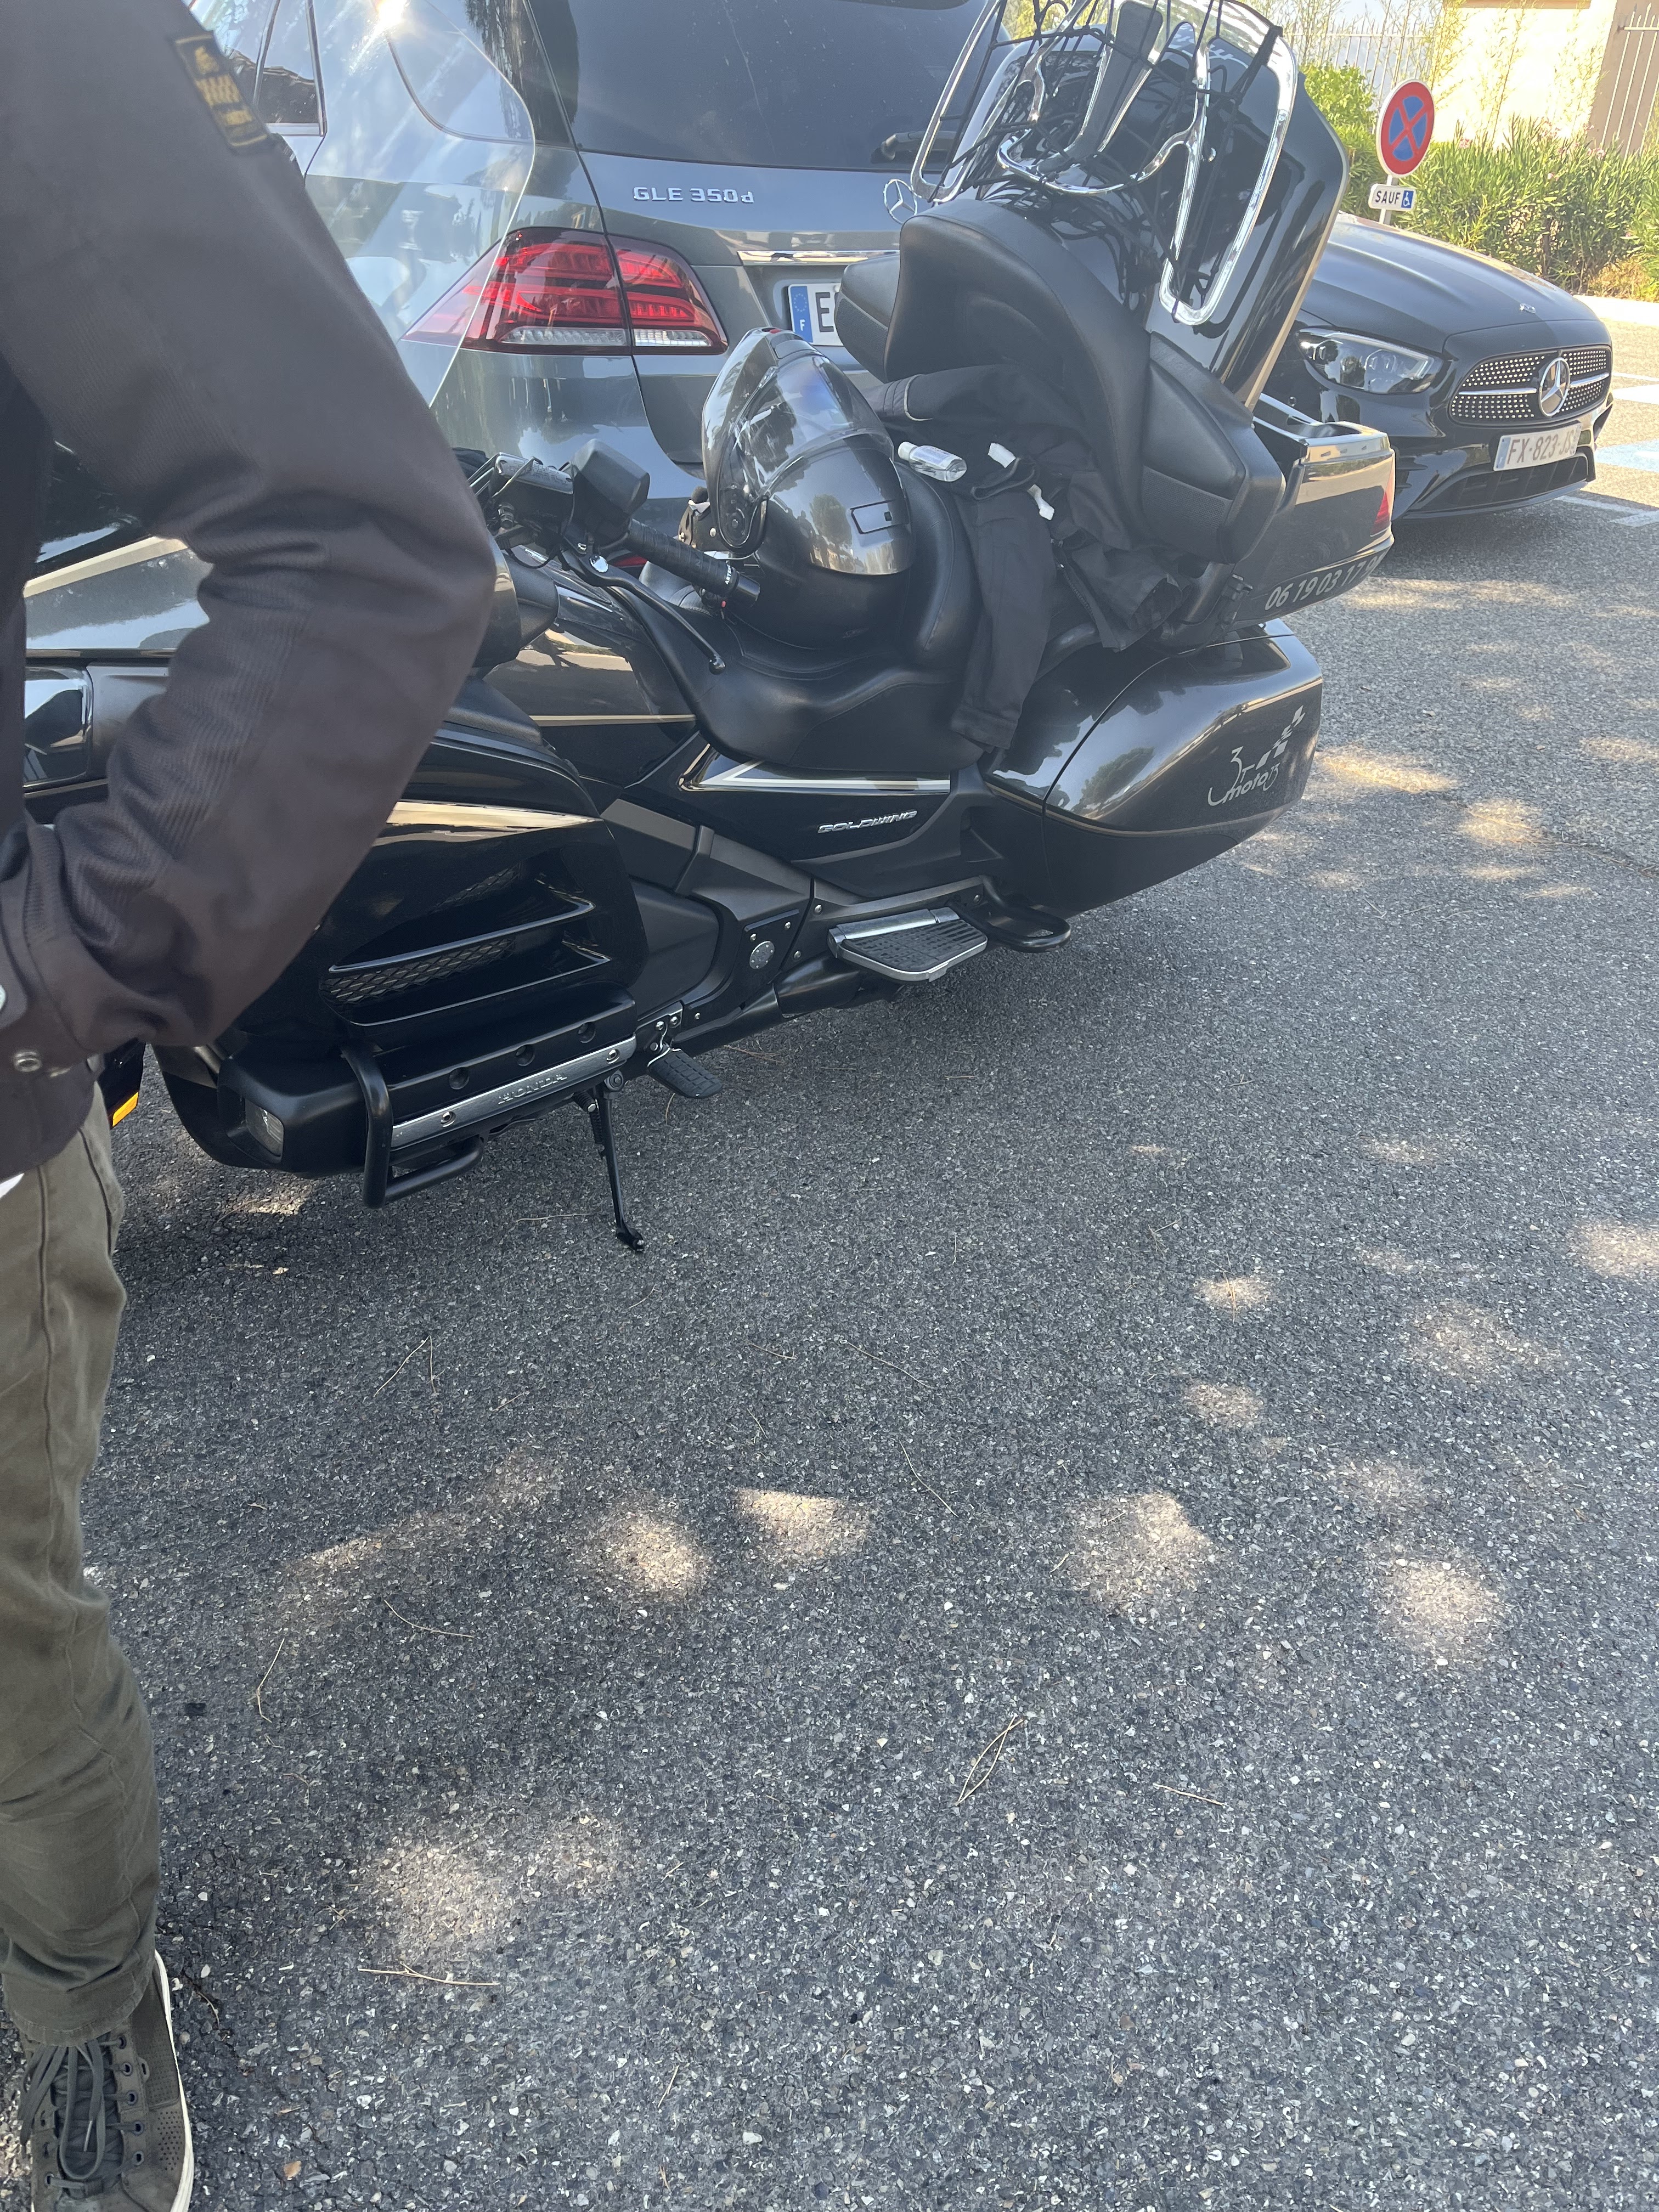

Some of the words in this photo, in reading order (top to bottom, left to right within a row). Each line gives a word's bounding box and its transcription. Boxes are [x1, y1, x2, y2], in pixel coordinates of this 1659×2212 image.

[633, 186, 683, 202] GLE
[690, 188, 755, 204] 350d
[1374, 189, 1402, 205] SAUF
[799, 319, 805, 331] F
[1265, 583, 1293, 611] 06
[1293, 576, 1318, 603] 19
[1316, 569, 1343, 596] 03
[1340, 560, 1367, 588] 17
